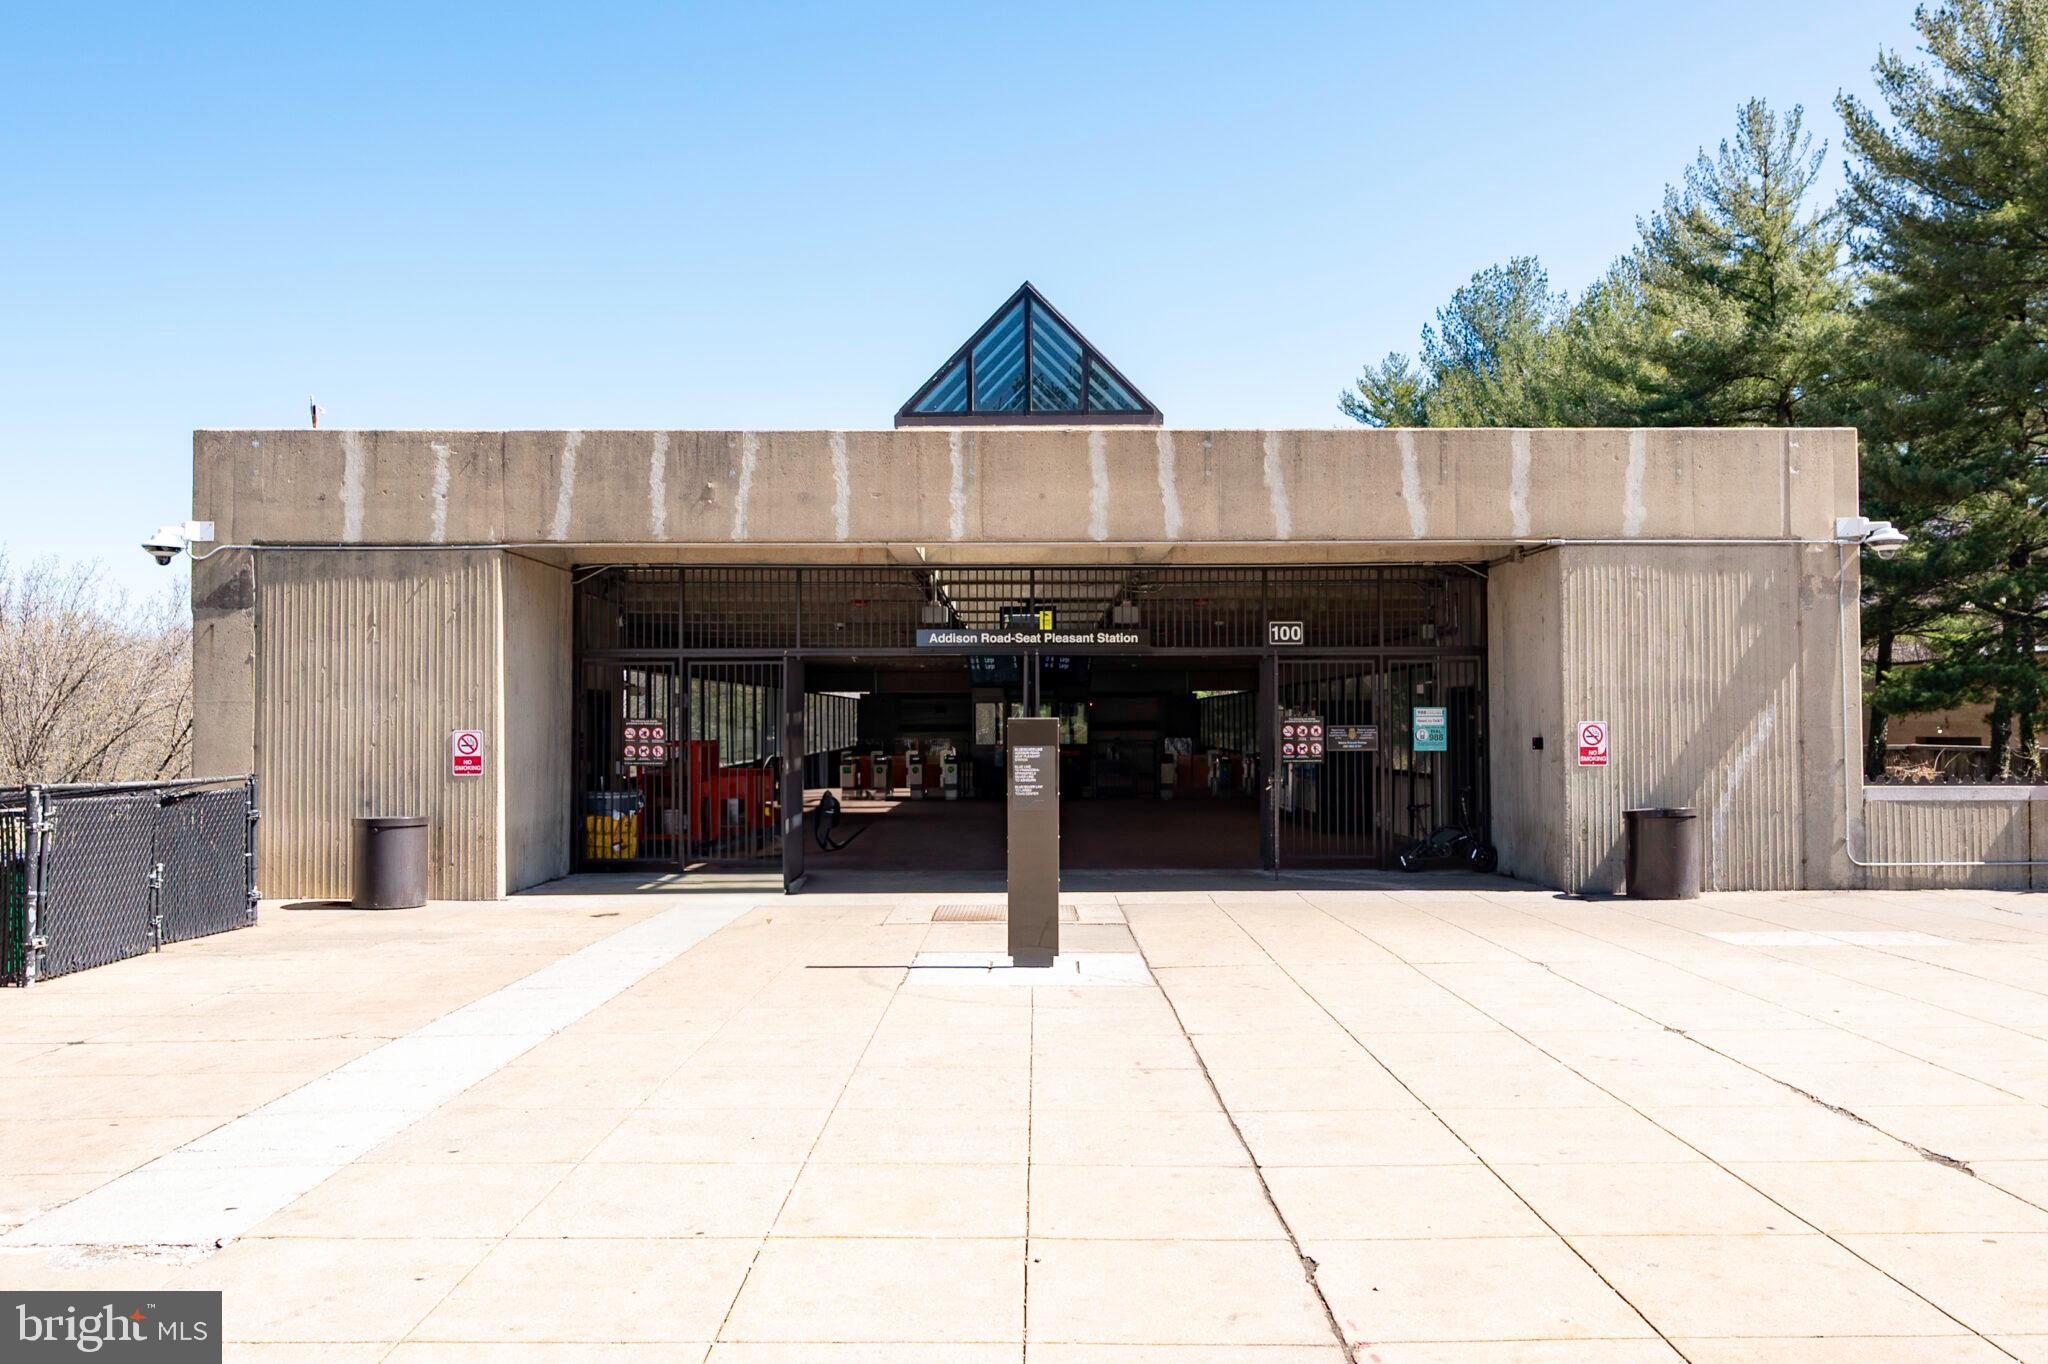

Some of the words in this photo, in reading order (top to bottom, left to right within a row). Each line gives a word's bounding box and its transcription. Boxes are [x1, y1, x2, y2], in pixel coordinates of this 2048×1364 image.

[929, 632, 978, 643] Addison
[981, 632, 1041, 643] Road-Seat
[1044, 632, 1094, 643] Pleasant
[1097, 632, 1139, 643] Station
[1271, 625, 1301, 641] 100
[1428, 734, 1444, 742] 988
